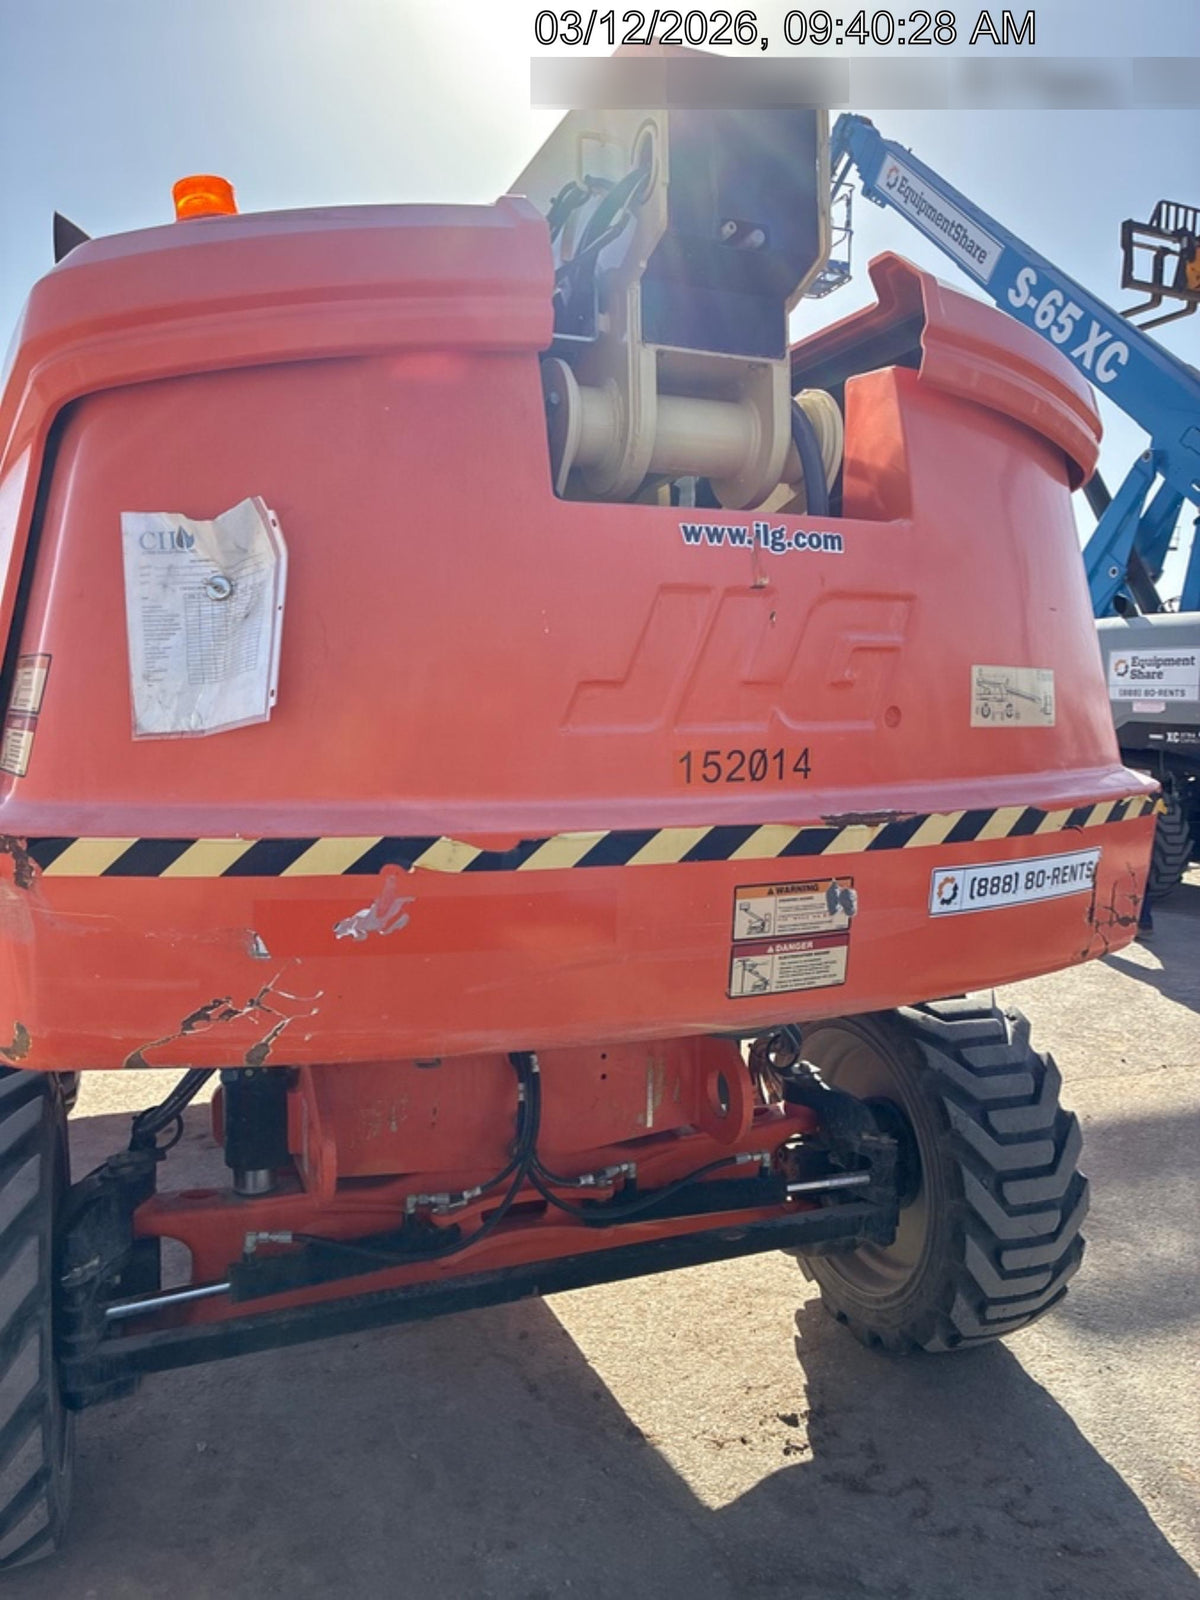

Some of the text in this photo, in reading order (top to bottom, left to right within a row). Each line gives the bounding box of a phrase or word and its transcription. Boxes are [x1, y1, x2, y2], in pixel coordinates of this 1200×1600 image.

[897, 176, 988, 264] EquipmentShare
[1007, 267, 1129, 383] S-65 XC
[1131, 655, 1196, 669] Equipment
[1130, 669, 1164, 680] Share
[1144, 689, 1186, 698] 80-RENTS
[969, 860, 1096, 900] (888) 80-RENTS
[776, 883, 819, 895] WARNING
[775, 941, 814, 953] DANGER
